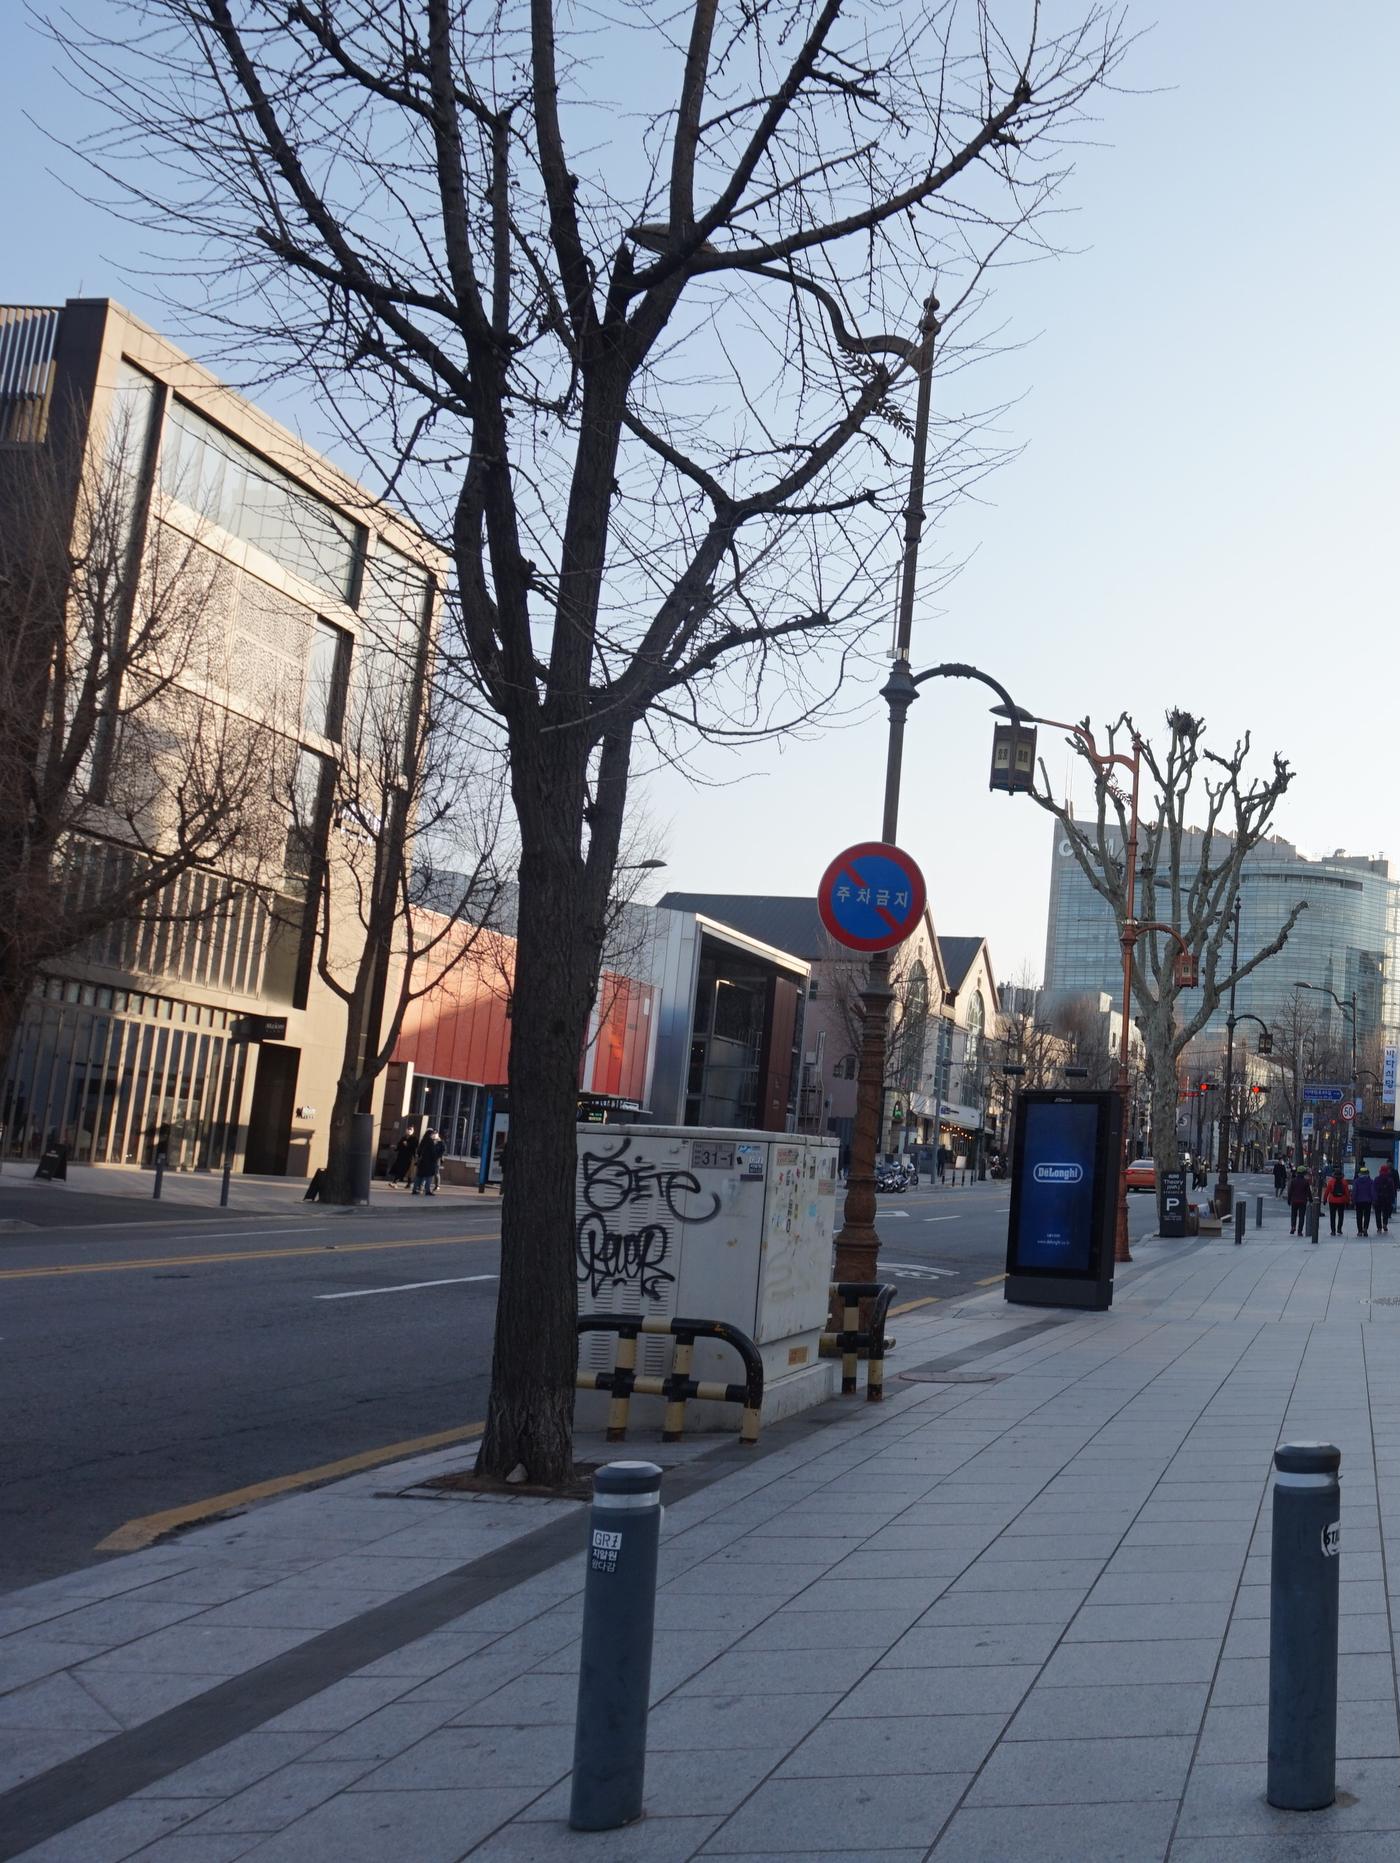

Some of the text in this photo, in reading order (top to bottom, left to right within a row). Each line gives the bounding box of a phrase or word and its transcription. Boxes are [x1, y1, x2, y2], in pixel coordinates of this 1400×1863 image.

[836, 886, 909, 908] 주차금지
[1344, 1107, 1353, 1117] 50
[702, 1151, 733, 1167] 31-1
[1166, 1197, 1180, 1212] P
